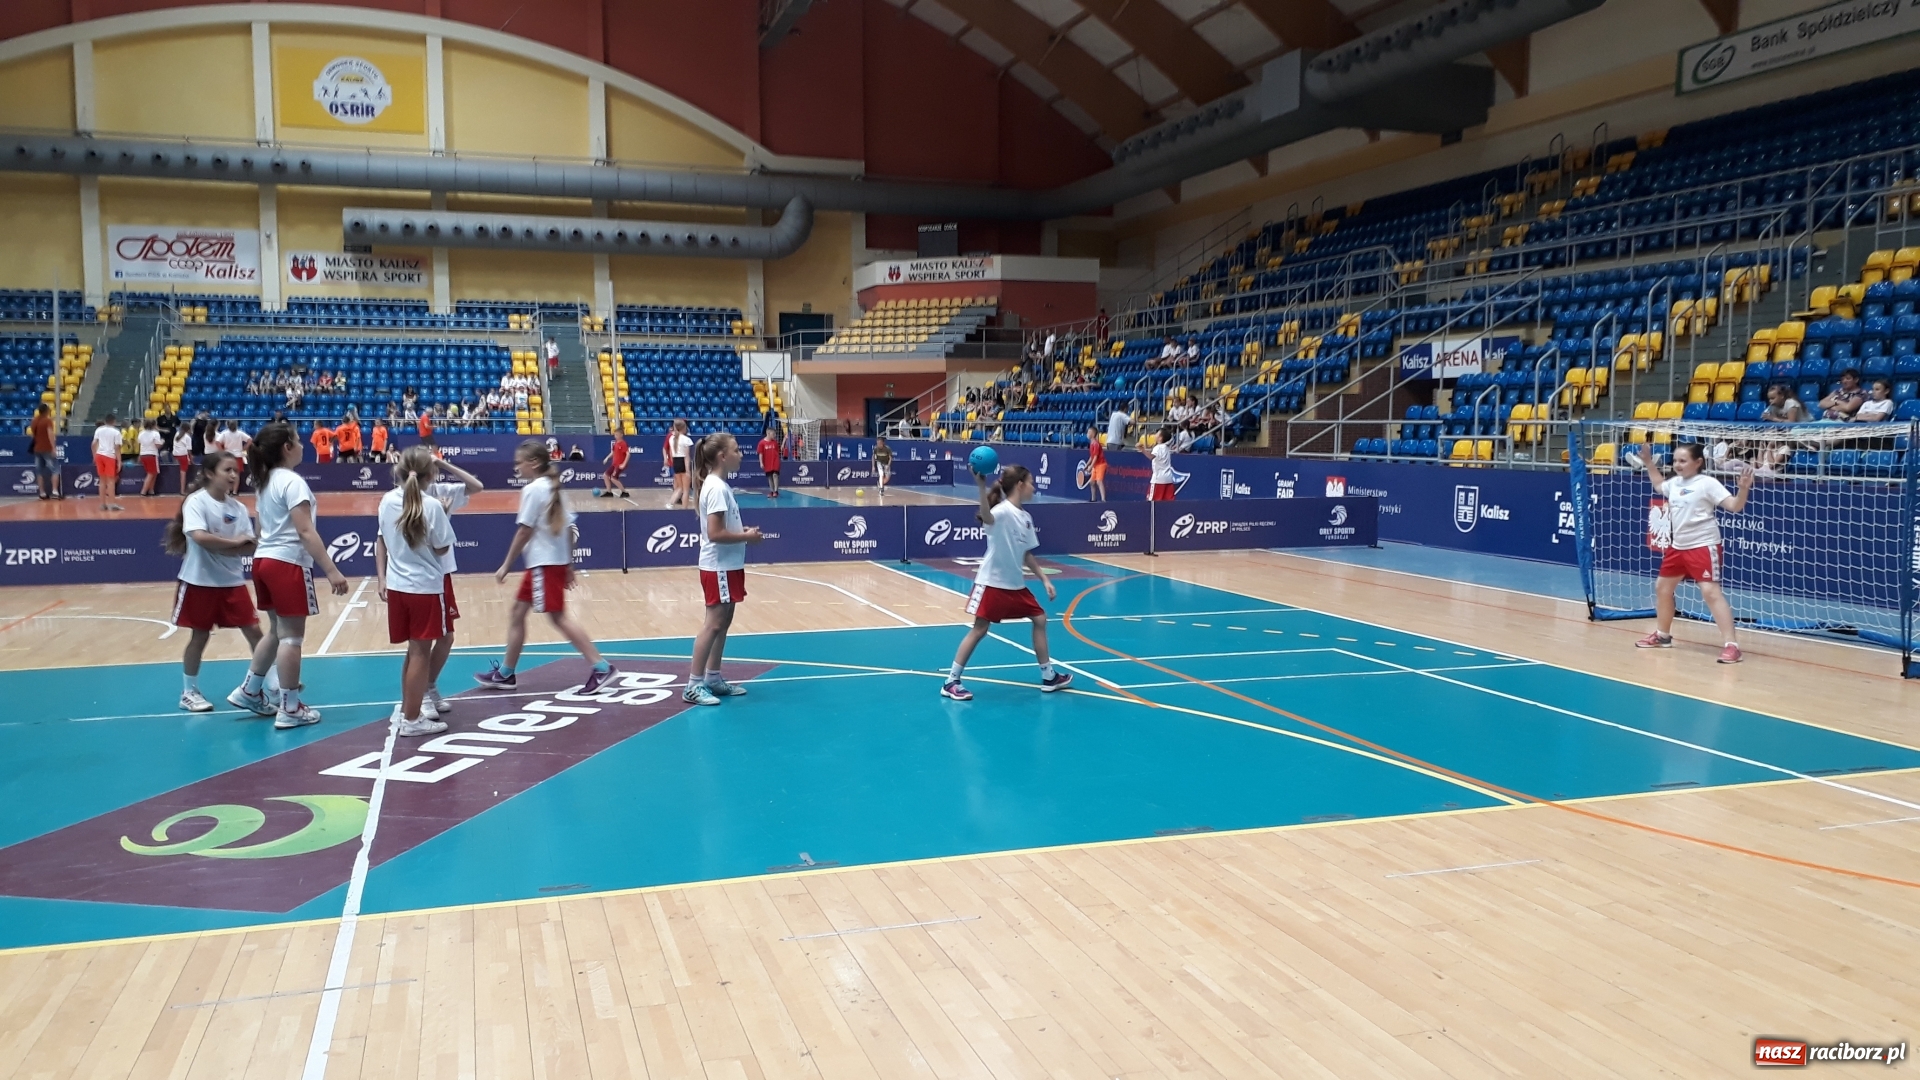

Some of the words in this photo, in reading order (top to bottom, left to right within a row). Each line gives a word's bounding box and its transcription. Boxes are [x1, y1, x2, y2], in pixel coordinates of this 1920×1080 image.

[1751, 29, 1788, 53] Bank
[1797, 1, 1900, 40] Spółdzielczy
[326, 257, 373, 269] MIASTO
[379, 259, 421, 271] KALISZ
[910, 261, 947, 272] MIASTO
[952, 258, 985, 270] KALISZ
[205, 264, 256, 280] Kalisz
[322, 270, 379, 282] WSPIERA
[383, 272, 424, 284] SPORT
[908, 272, 950, 282] WSPIERA
[955, 270, 986, 280] SPORT
[1402, 353, 1431, 370] Kalisz
[1277, 488, 1294, 499] FAIR
[1347, 485, 1388, 498] Ministerstwo
[1379, 504, 1402, 516] rystyki
[1480, 505, 1510, 523] Kalisz
[1195, 520, 1228, 535] ZPRP
[1333, 526, 1355, 536] SPORTU
[852, 539, 877, 549] SPORTU
[1103, 533, 1127, 542] SPORTU
[6, 548, 58, 566] ZPRP
[318, 671, 679, 783] Energa
